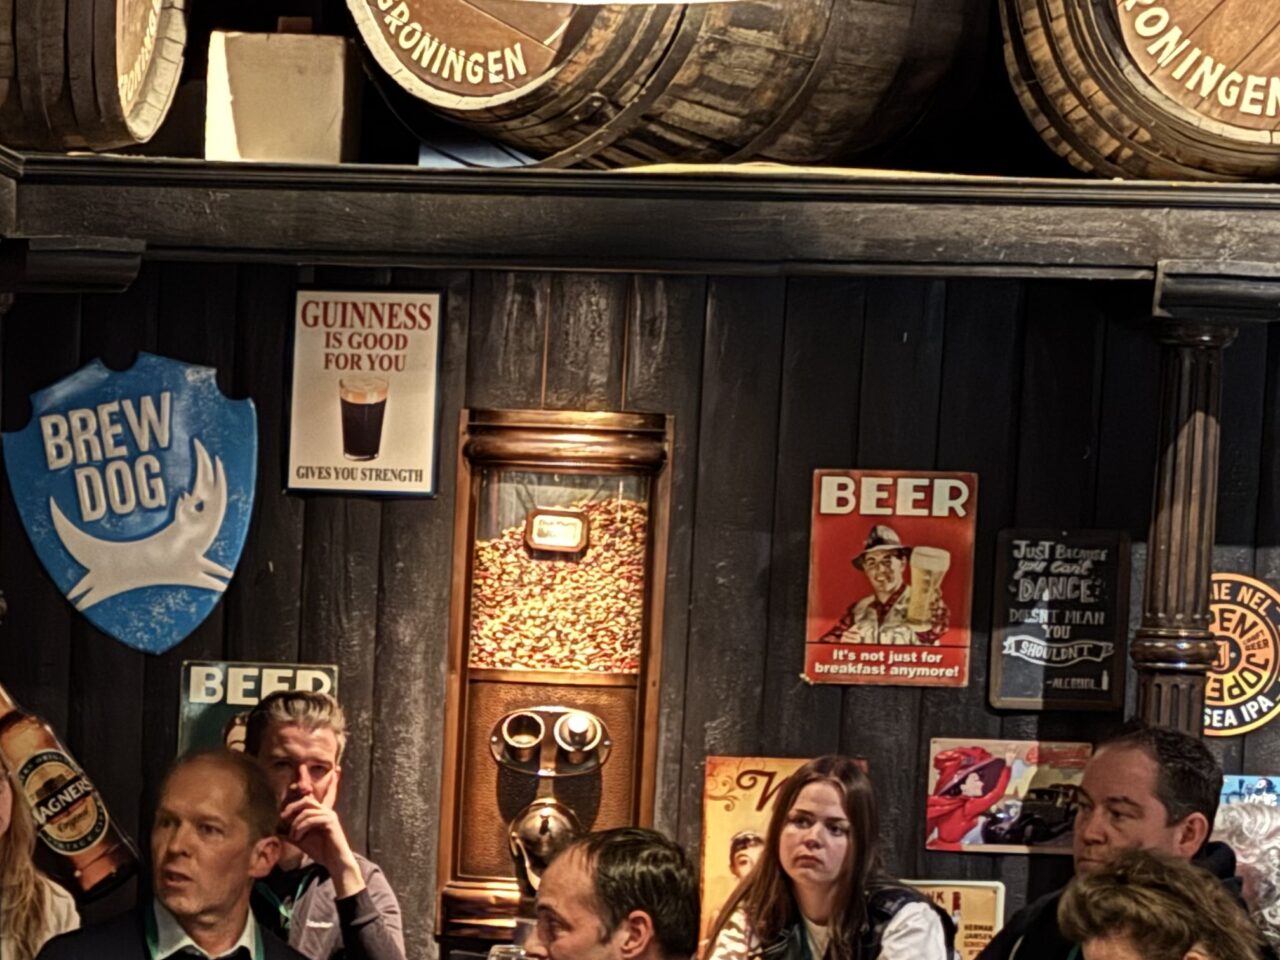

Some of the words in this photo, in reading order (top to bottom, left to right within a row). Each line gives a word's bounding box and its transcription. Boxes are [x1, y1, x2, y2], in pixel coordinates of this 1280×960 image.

[1124, 0, 1280, 116] ONINGE
[301, 300, 432, 331] GUINNESS
[324, 331, 343, 349] IS
[348, 332, 408, 350] GOOD
[324, 353, 362, 370] FOR
[367, 354, 406, 372] YOU
[40, 391, 171, 470] BREW
[296, 466, 331, 479] GIVES
[334, 467, 358, 480] YOU
[361, 468, 423, 482] STRENGTH
[74, 455, 166, 522] DOG
[819, 476, 970, 517] BEER
[1019, 577, 1094, 603] DANCE
[1042, 624, 1071, 638] YOU
[833, 649, 856, 660] It's
[860, 650, 885, 661] not
[888, 650, 917, 664] just
[921, 651, 943, 663] for
[815, 662, 885, 675] breakfast
[890, 665, 959, 678] anymore!
[1240, 694, 1275, 722] IPA
